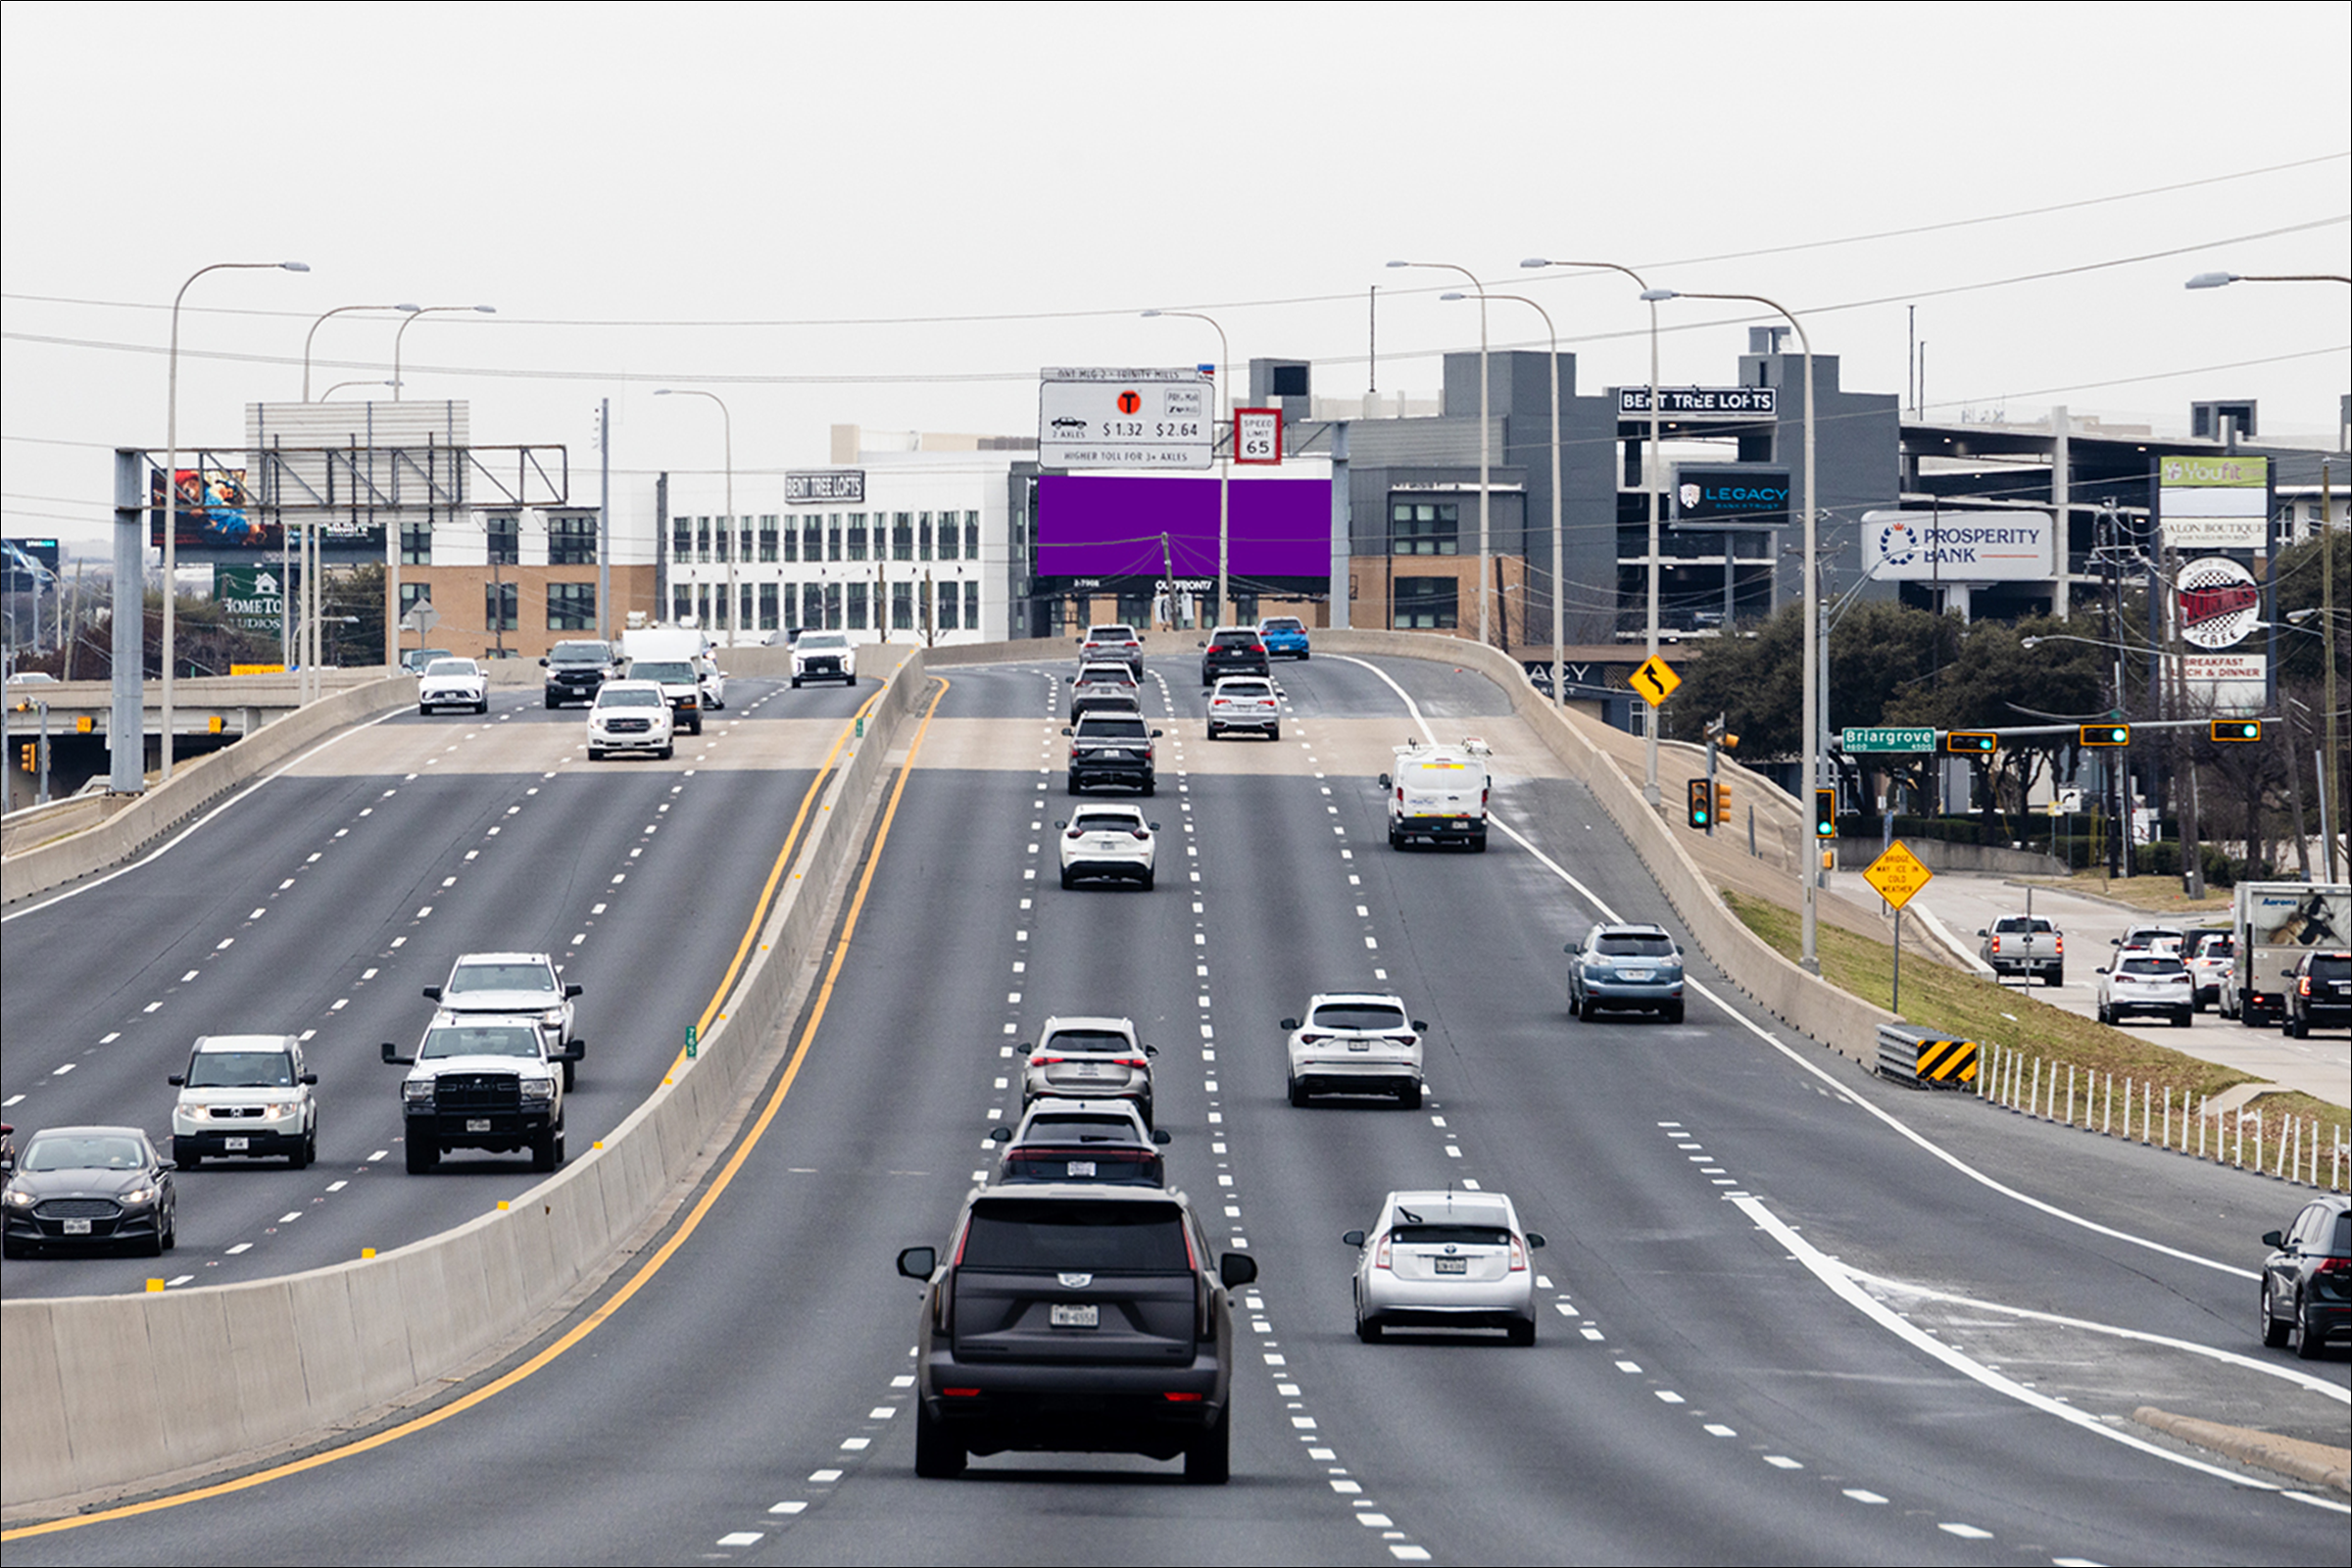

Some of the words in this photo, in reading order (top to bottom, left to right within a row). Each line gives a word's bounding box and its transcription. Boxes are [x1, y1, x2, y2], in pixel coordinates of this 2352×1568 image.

[1154, 369, 1180, 379] MILLS
[1673, 394, 1714, 409] TREE
[1719, 394, 1771, 409] LOFTS
[1060, 429, 1086, 439] AXLES
[1247, 440, 1270, 454] 65
[1064, 452, 1098, 462] HIGHER
[1101, 452, 1122, 462] TOLL
[1124, 452, 1143, 462] FOR
[1160, 452, 1188, 462] AXLES
[1705, 487, 1788, 501] LEGACY
[1924, 528, 2040, 544] PROSPERITY
[2204, 523, 2266, 535] BOUTIQUE
[1924, 549, 1977, 564] BANK
[2171, 668, 2204, 677] LCH
[2219, 668, 2260, 677] DINNER
[1846, 729, 1932, 746] Briargrove
